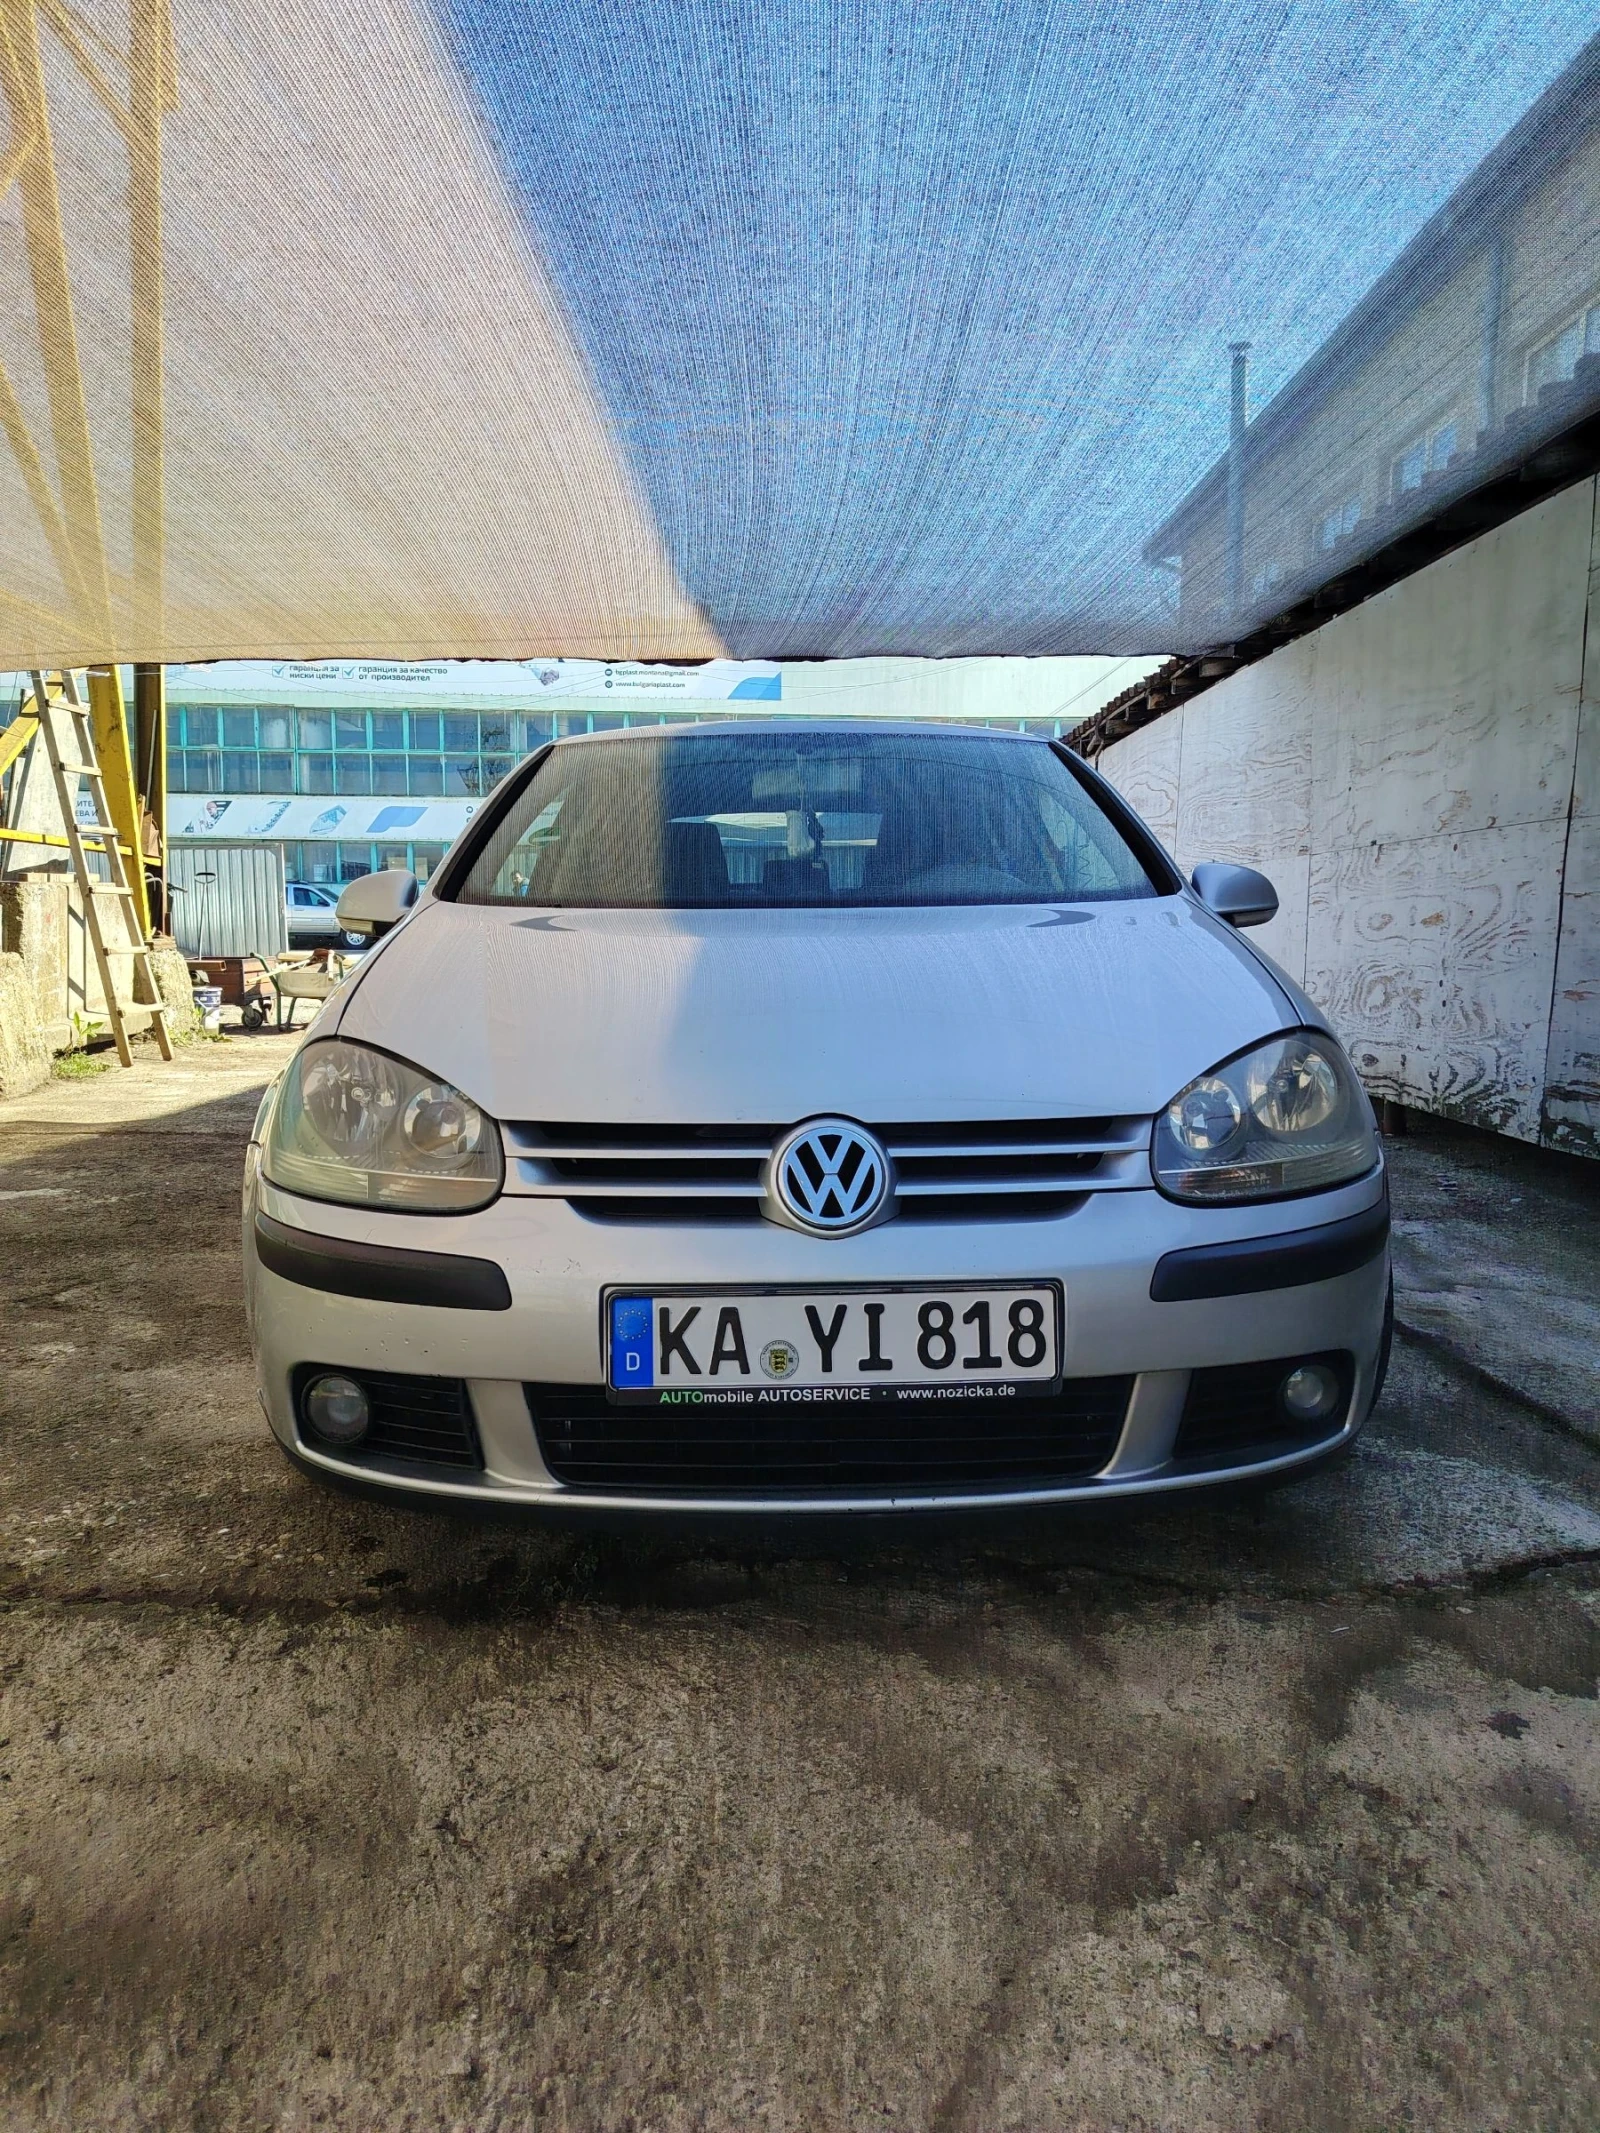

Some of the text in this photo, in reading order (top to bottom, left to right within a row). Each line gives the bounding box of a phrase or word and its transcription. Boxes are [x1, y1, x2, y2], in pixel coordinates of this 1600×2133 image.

[358, 666, 398, 674] гаранция
[371, 674, 431, 682] производител
[659, 1298, 1047, 1375] KA YI 818
[626, 1352, 640, 1371] D
[659, 1384, 1016, 1404] AUTOmobile AUTOSERVICE www.nozicka.de
